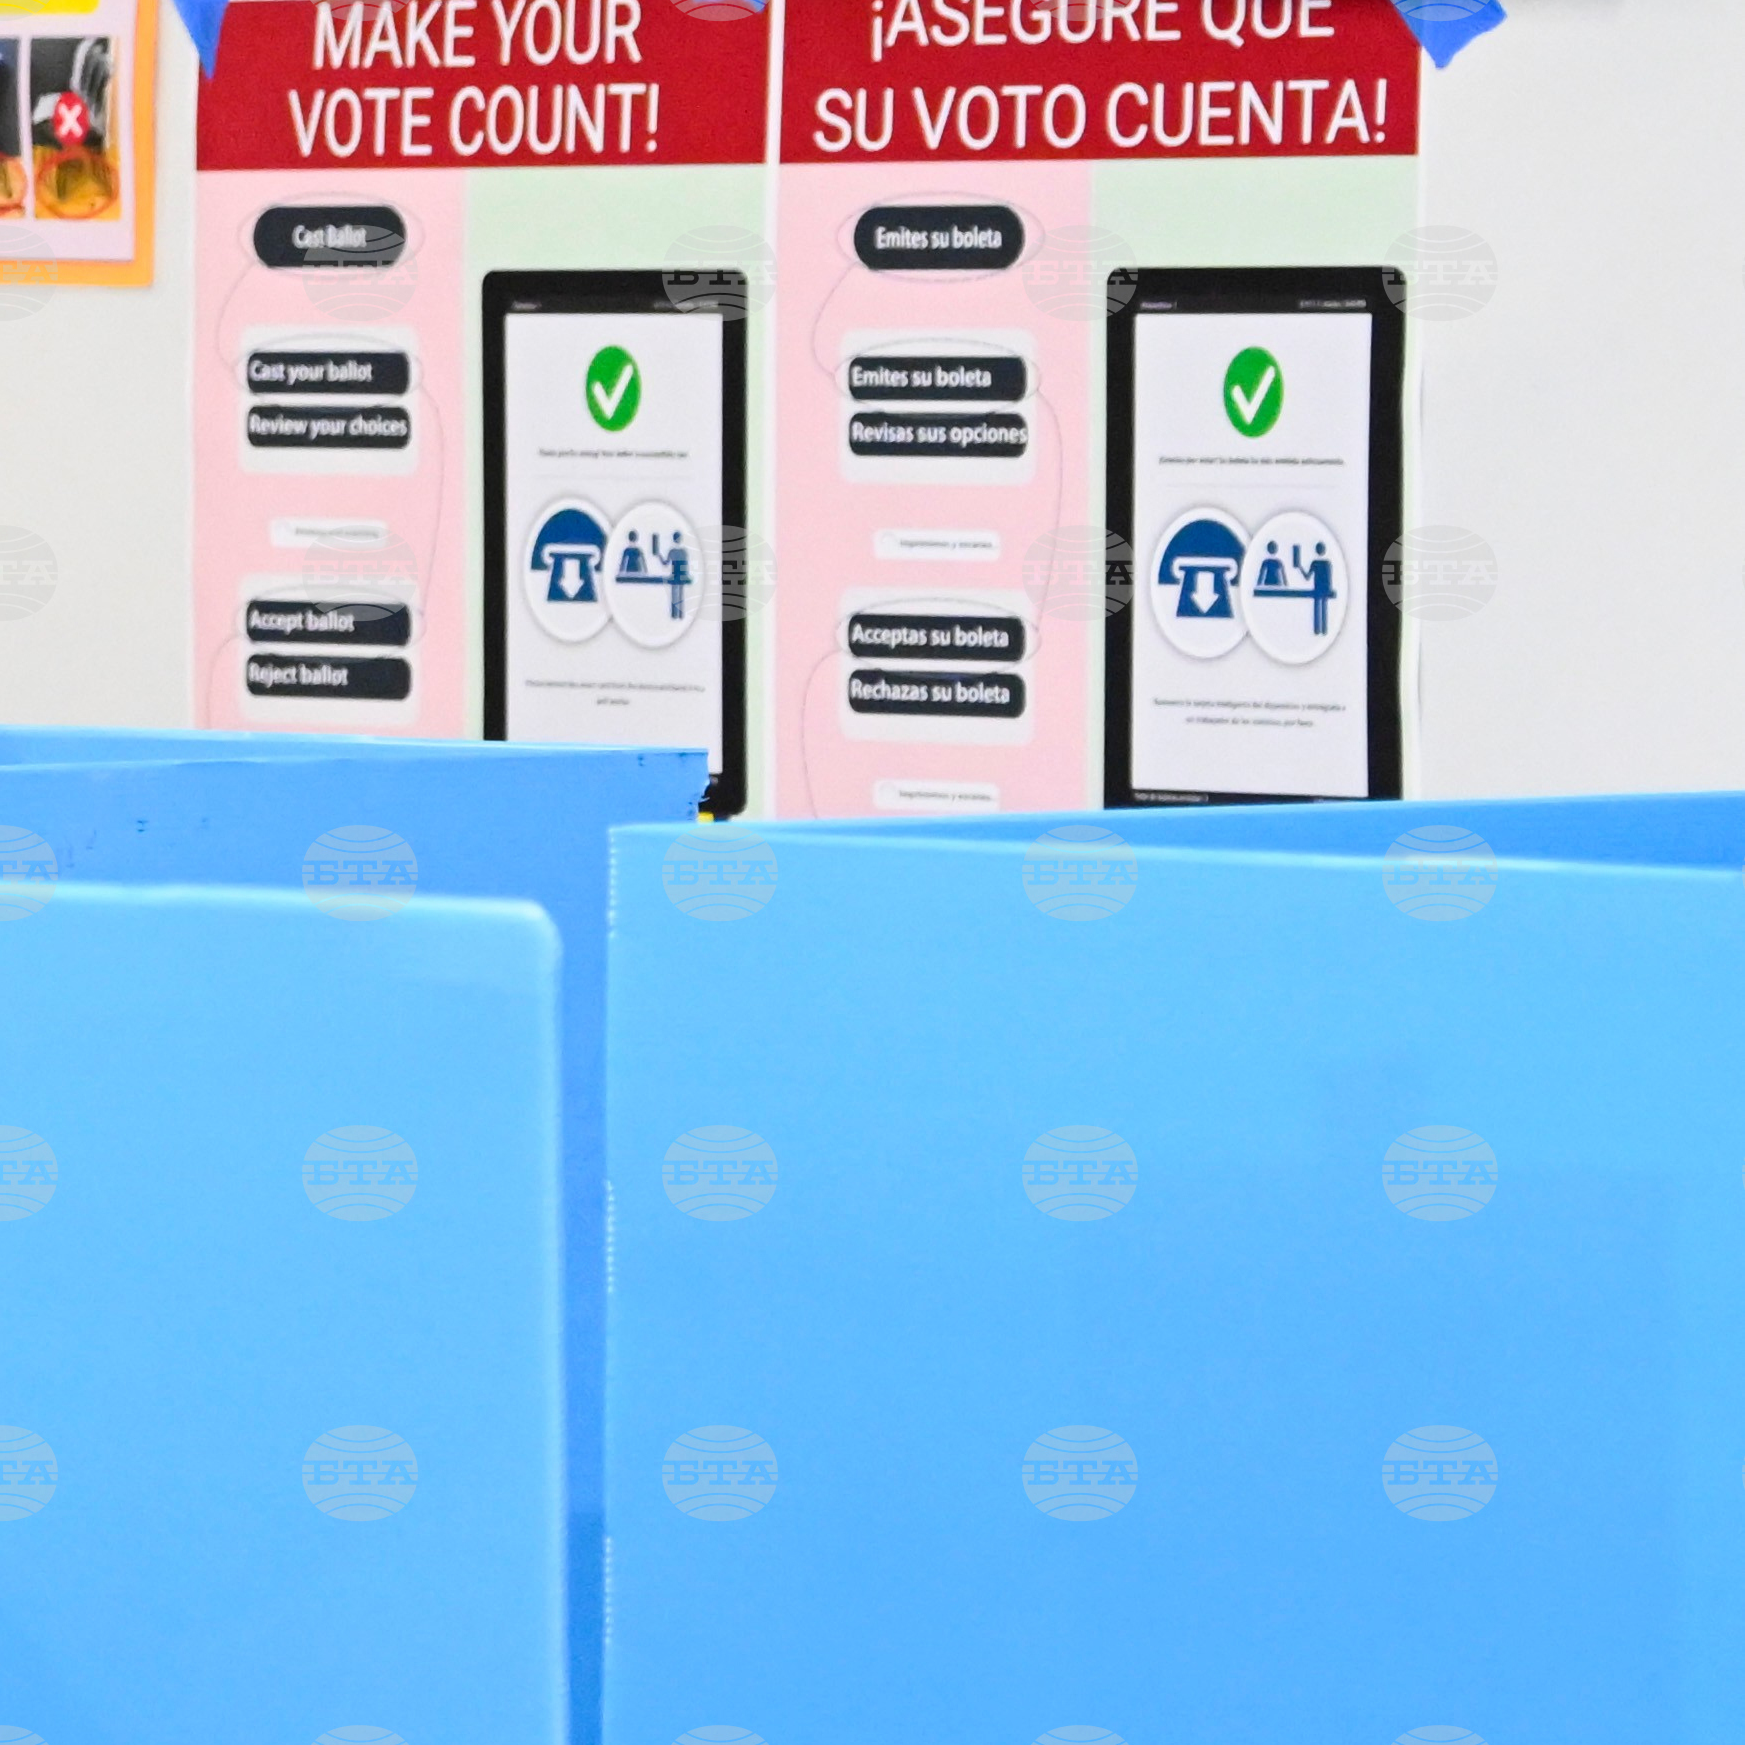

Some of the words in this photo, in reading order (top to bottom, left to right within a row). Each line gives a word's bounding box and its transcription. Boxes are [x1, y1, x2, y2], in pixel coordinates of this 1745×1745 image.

[288, 86, 434, 158] VOTE
[449, 82, 660, 156] COUNT!
[813, 87, 894, 152] SU
[912, 83, 1087, 150] VOTO
[1107, 78, 1387, 147] CUENTA!
[292, 225, 324, 249] Cast
[326, 224, 367, 248] Ballot
[874, 226, 928, 249] Emites
[931, 230, 949, 249] su
[953, 225, 1002, 249] boleta
[250, 359, 285, 381] Cast
[286, 363, 324, 385] your
[326, 359, 373, 382] ballot
[852, 366, 908, 387] Emites
[911, 370, 932, 387] su
[935, 366, 992, 387] boleta
[250, 414, 307, 435] Review
[308, 419, 347, 440] your
[349, 414, 408, 436] choices
[852, 421, 913, 443] Revisas
[916, 426, 946, 443] sus
[950, 422, 1029, 448] opciones
[250, 610, 303, 635] Accept
[304, 610, 355, 632] ballot
[852, 624, 927, 649] Acceptas
[930, 630, 951, 646] su
[954, 625, 1009, 648] boleta
[249, 663, 297, 688] Reject
[299, 663, 348, 686] ballot
[851, 679, 928, 702] Rechazas
[932, 686, 952, 702] su
[955, 681, 1011, 704] boleta
